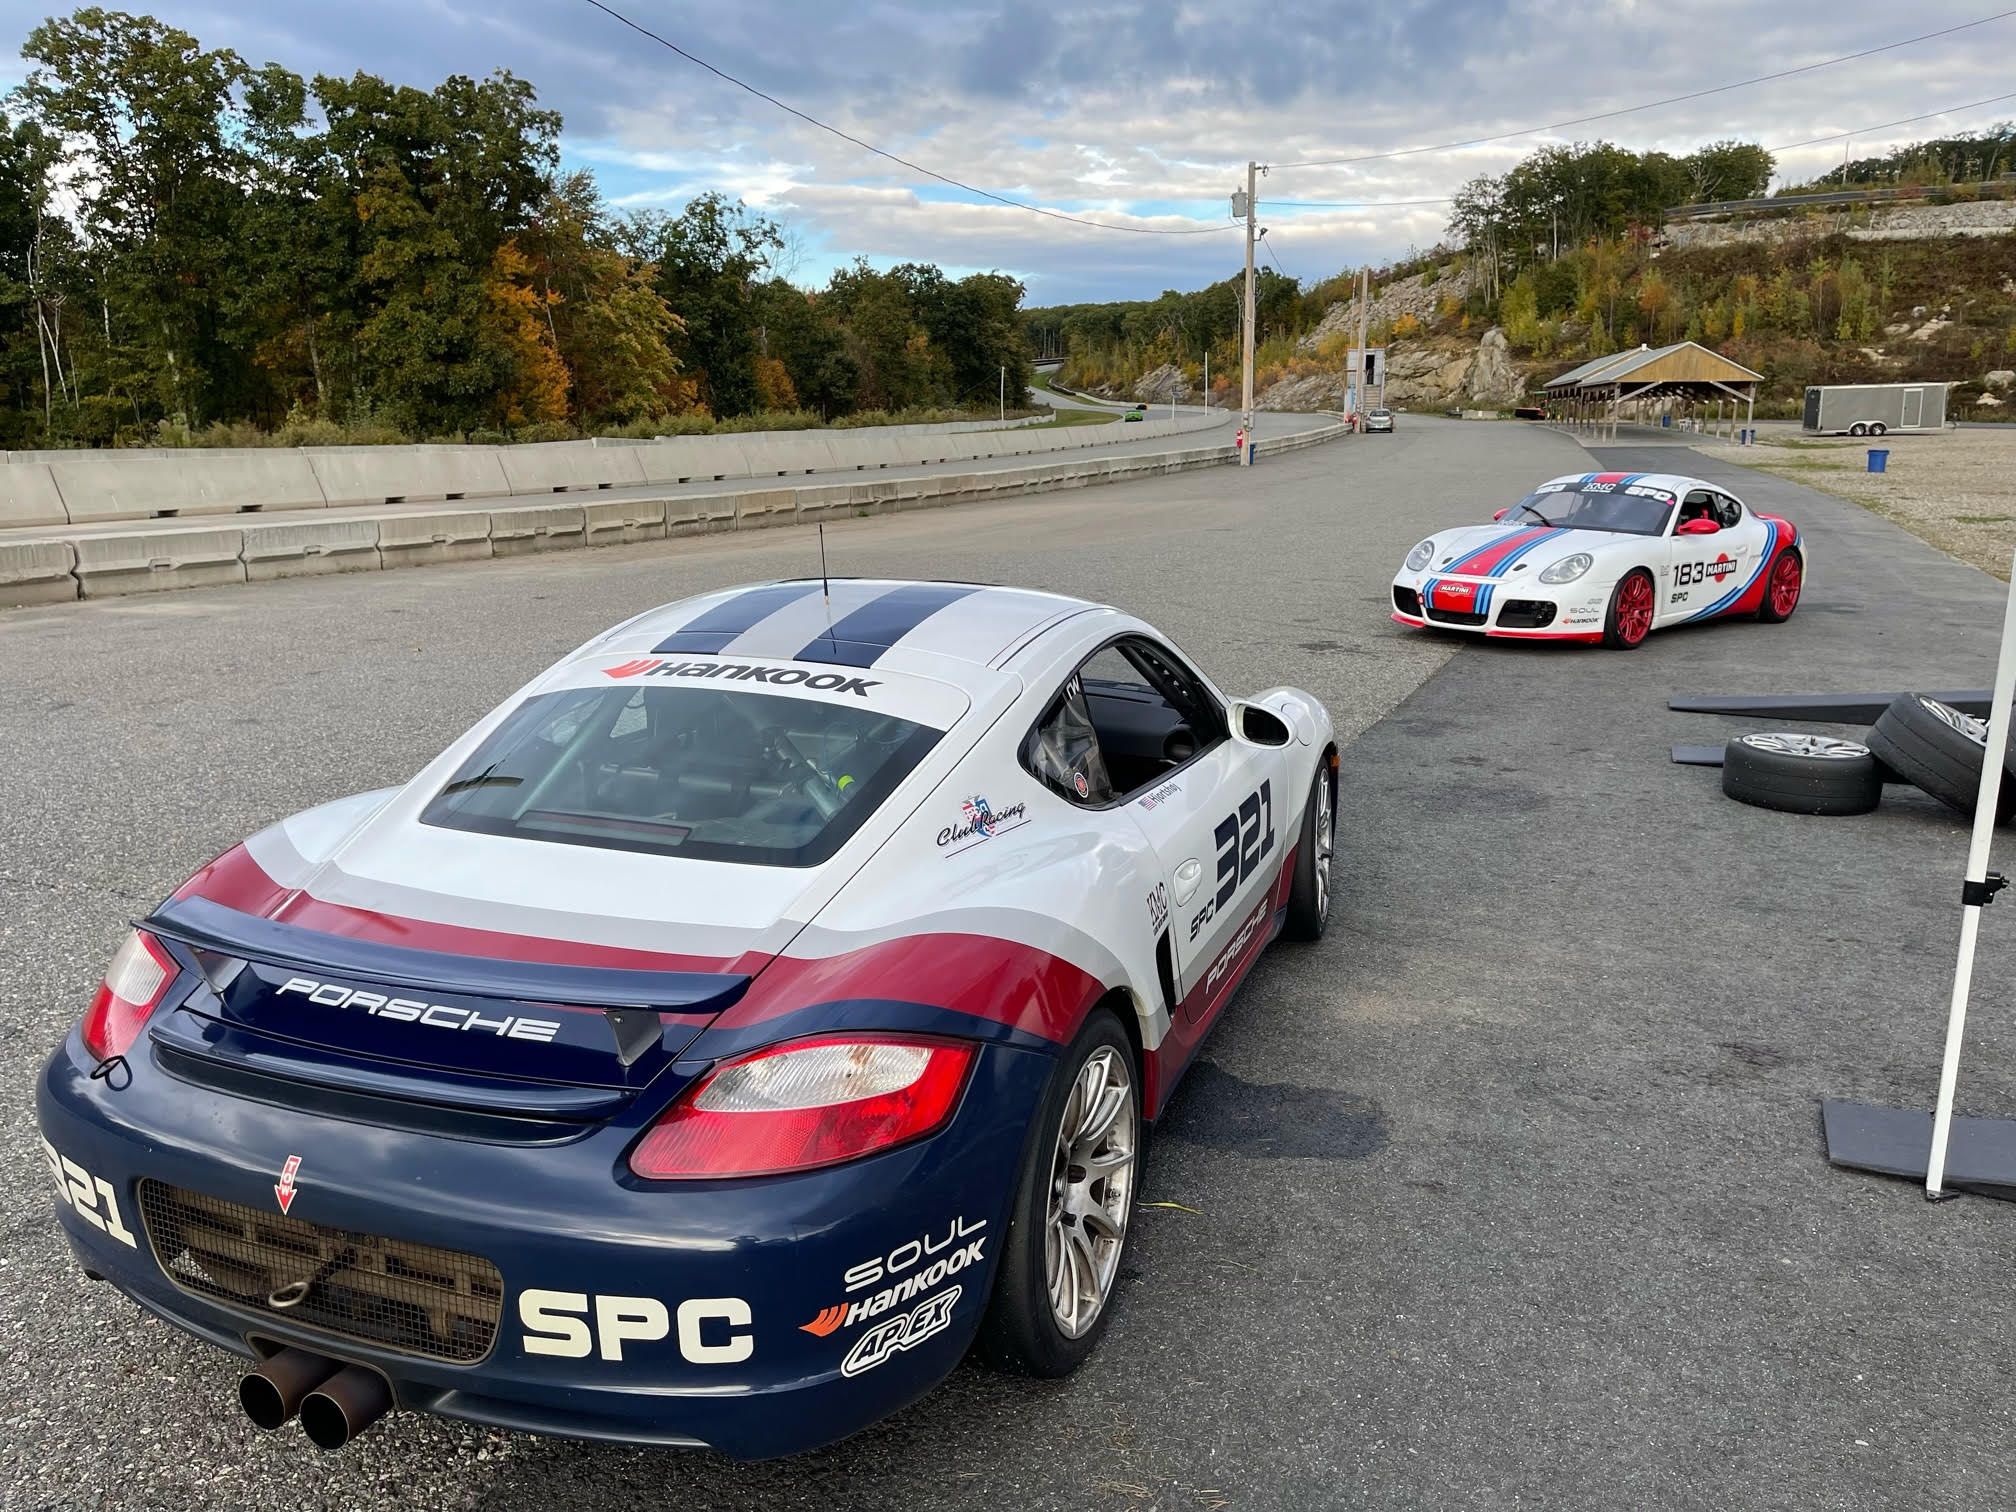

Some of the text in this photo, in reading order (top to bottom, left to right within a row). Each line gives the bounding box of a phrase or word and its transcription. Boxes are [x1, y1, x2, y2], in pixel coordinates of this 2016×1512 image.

[1441, 585, 1469, 594] MARTINI
[1674, 562, 1704, 587] 183
[1707, 560, 1736, 576] MARTINI
[937, 815, 978, 847] Club
[980, 802, 1026, 828] Racing
[1214, 778, 1275, 914] 321
[1189, 898, 1215, 943] SPC
[1206, 899, 1269, 994] PORSCHE
[275, 977, 561, 1042] PORSCHE
[282, 1161, 297, 1197] TOW
[844, 1215, 987, 1292] SOUL
[519, 1288, 754, 1364] SPC
[850, 1289, 960, 1366] APEX
